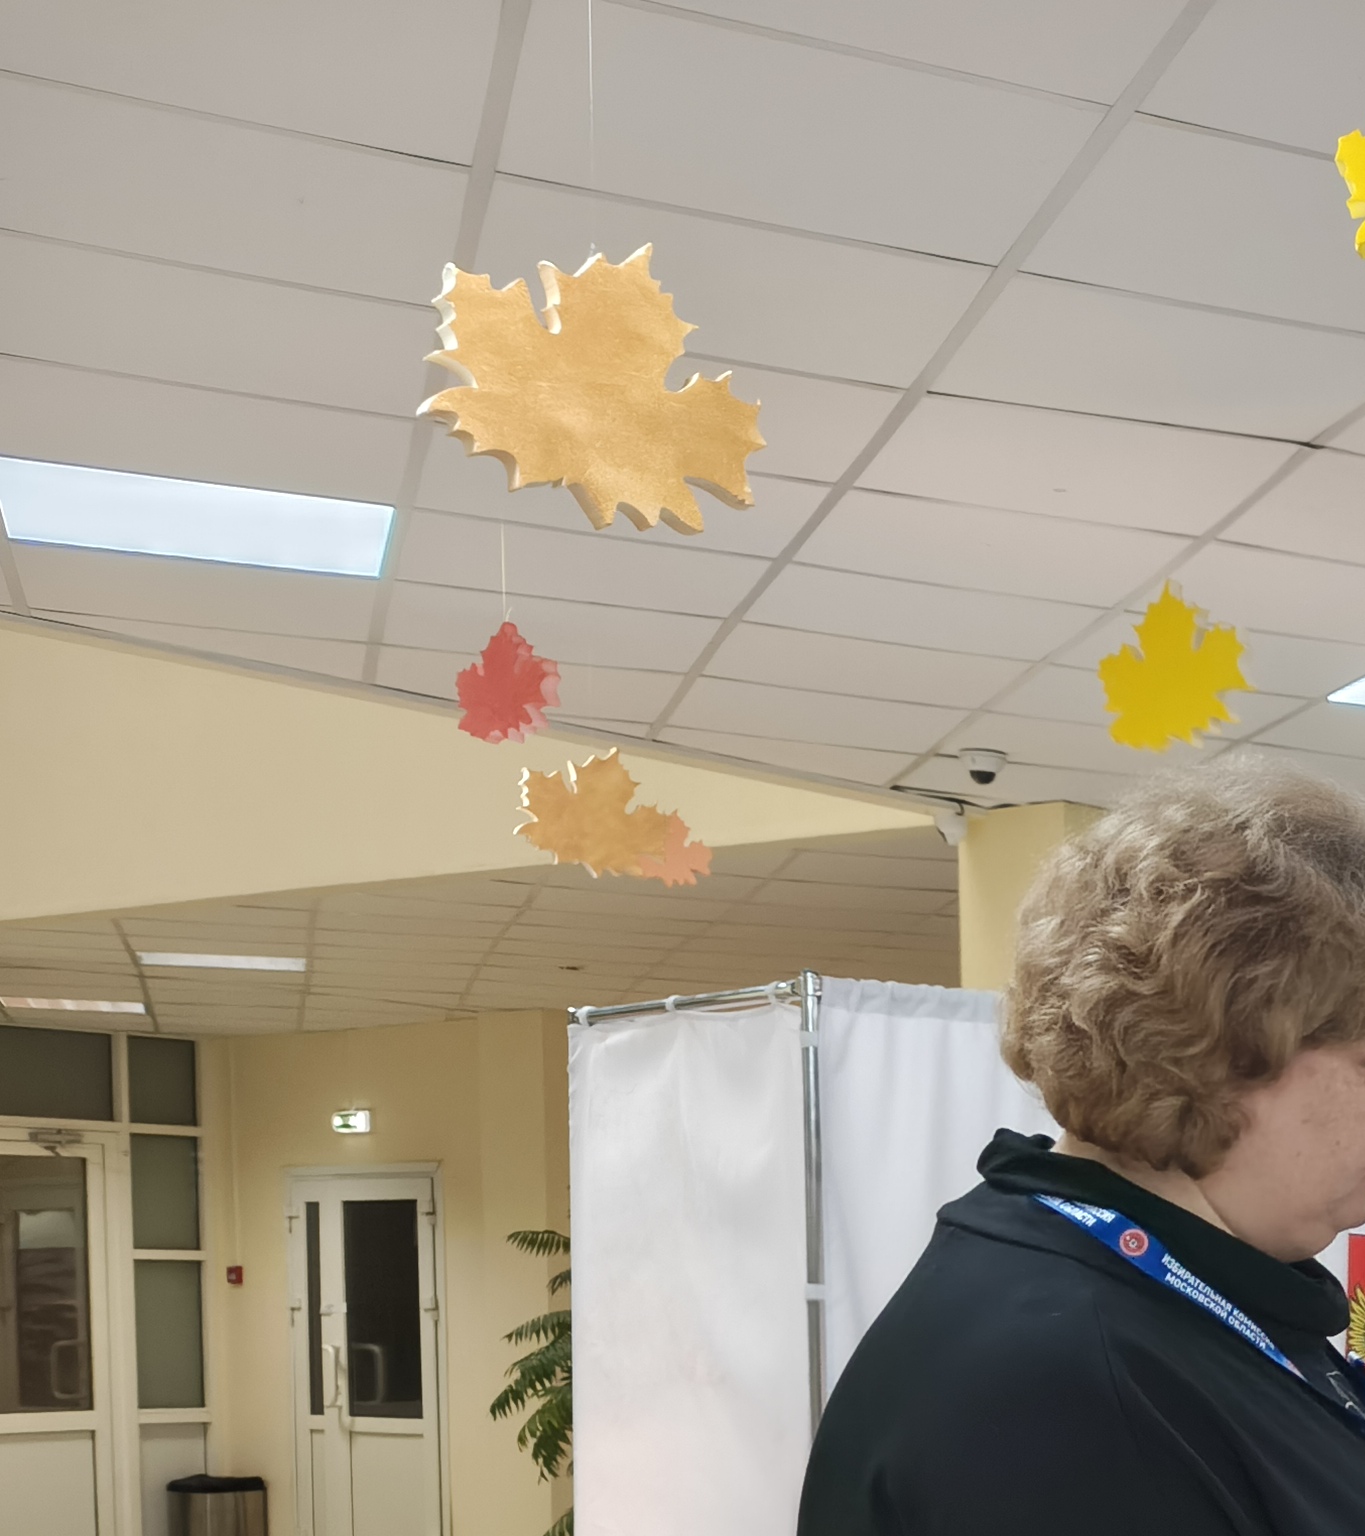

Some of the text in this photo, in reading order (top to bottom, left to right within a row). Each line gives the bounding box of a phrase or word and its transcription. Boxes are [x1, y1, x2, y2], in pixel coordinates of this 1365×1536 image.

[1161, 1252, 1231, 1313] ИЗБИРАТЕЛЬНАЯ
[1164, 1272, 1267, 1350] МОСКОВСКОЙ ОБЛАСТИ
